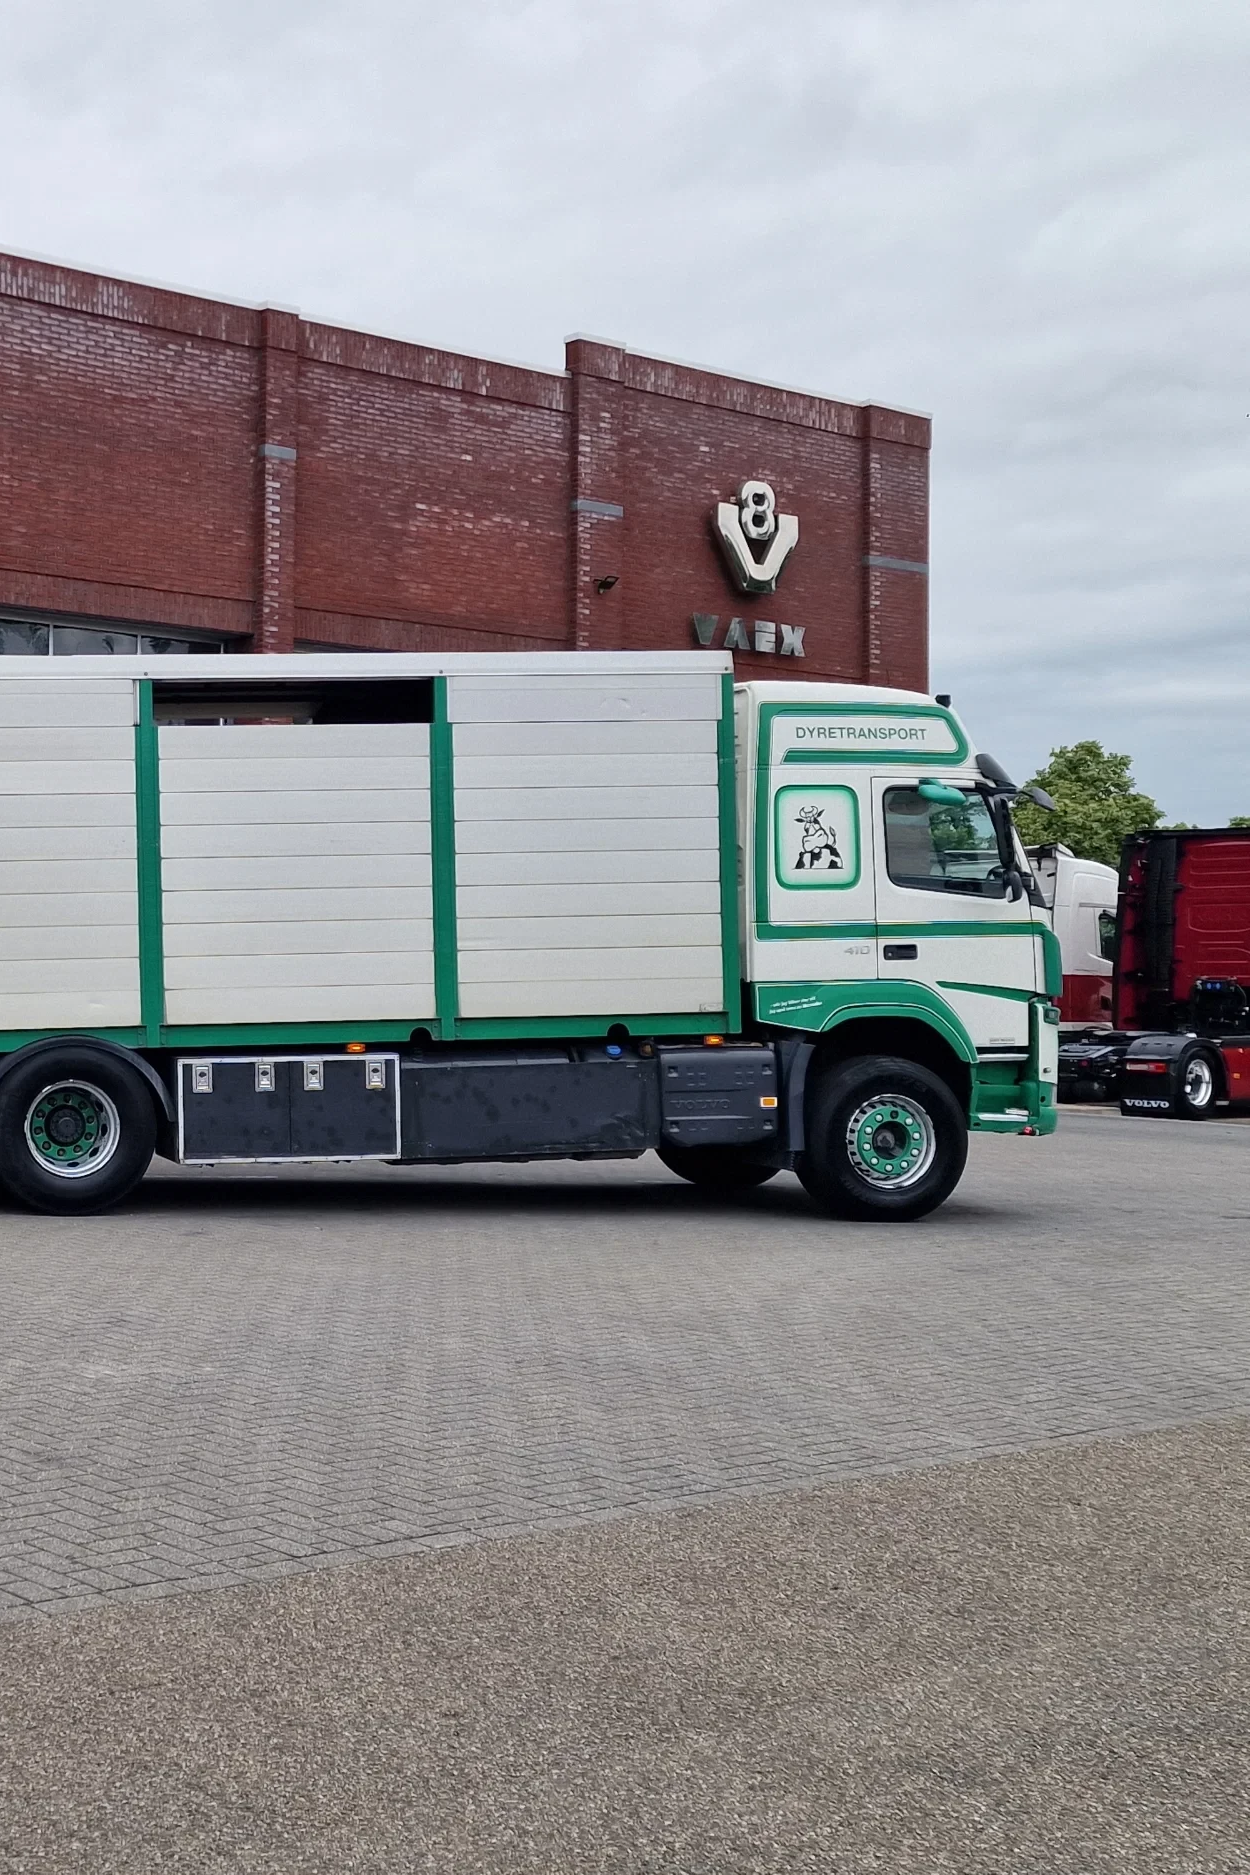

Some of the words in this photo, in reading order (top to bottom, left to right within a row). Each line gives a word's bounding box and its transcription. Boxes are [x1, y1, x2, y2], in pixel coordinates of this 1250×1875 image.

[692, 612, 806, 657] VAEX
[795, 726, 927, 741] DYRETRANSPORT
[844, 945, 870, 955] 410
[669, 1099, 731, 1110] VOLVO
[1123, 1098, 1169, 1109] VOLVO
